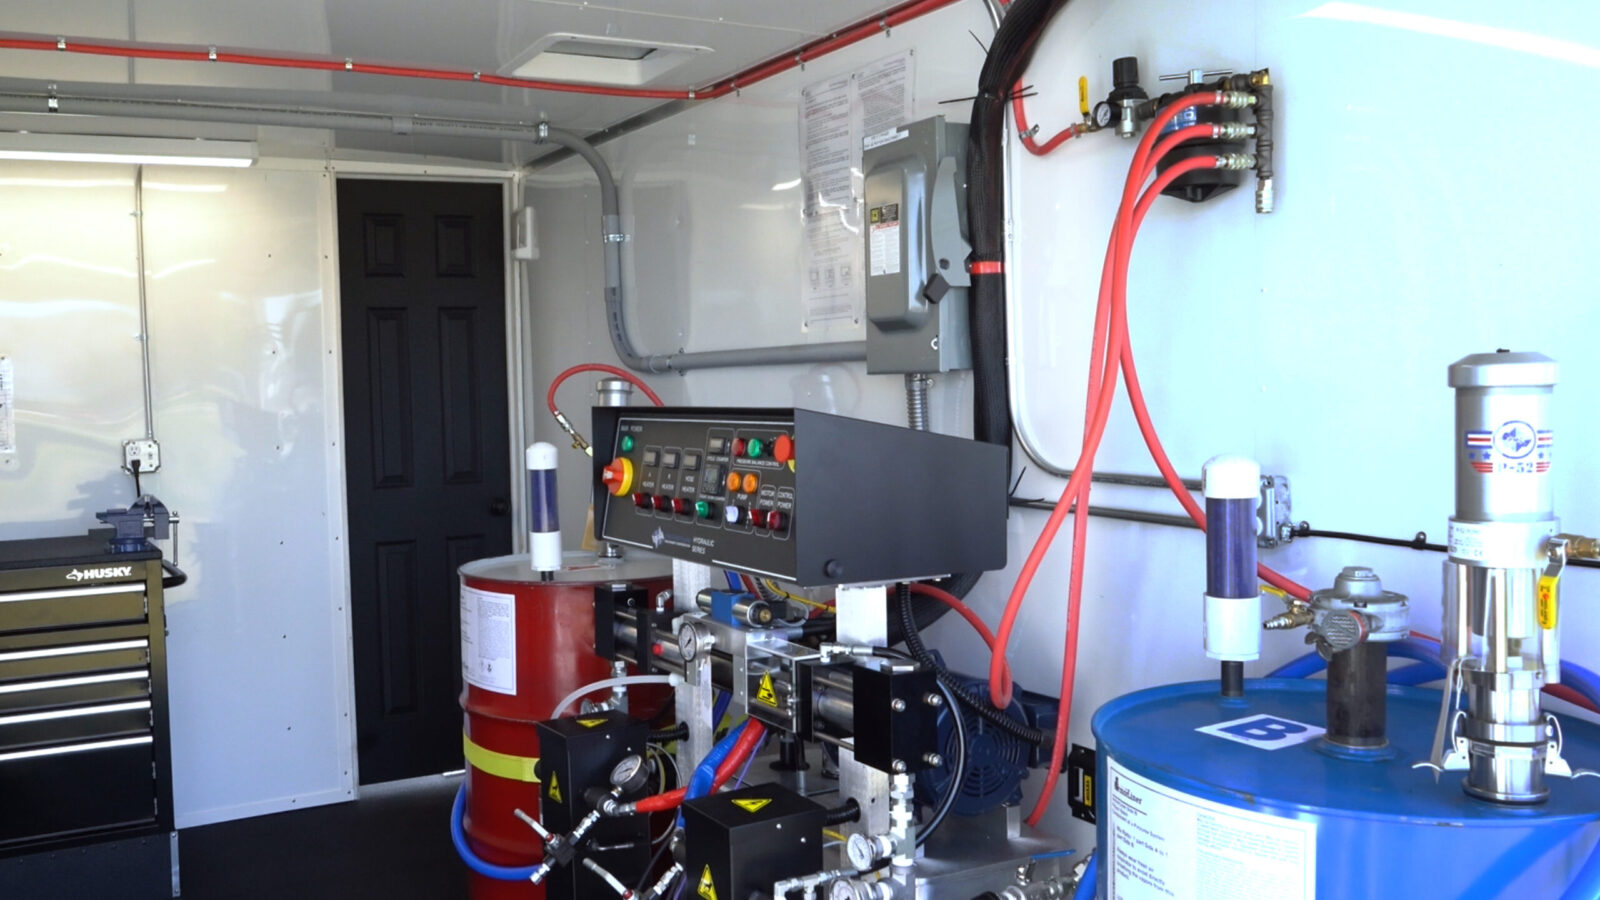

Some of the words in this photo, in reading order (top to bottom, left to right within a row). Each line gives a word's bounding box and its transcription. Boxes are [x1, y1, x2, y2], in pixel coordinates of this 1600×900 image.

[761, 489, 775, 497] MOTOR
[777, 491, 793, 499] CONTROL
[760, 499, 774, 507] POWER
[777, 501, 792, 509] POWER
[692, 536, 715, 548] HYDRAULIC
[691, 544, 706, 555] SERIES
[83, 566, 132, 580] HUSKY
[1216, 717, 1309, 742] B
